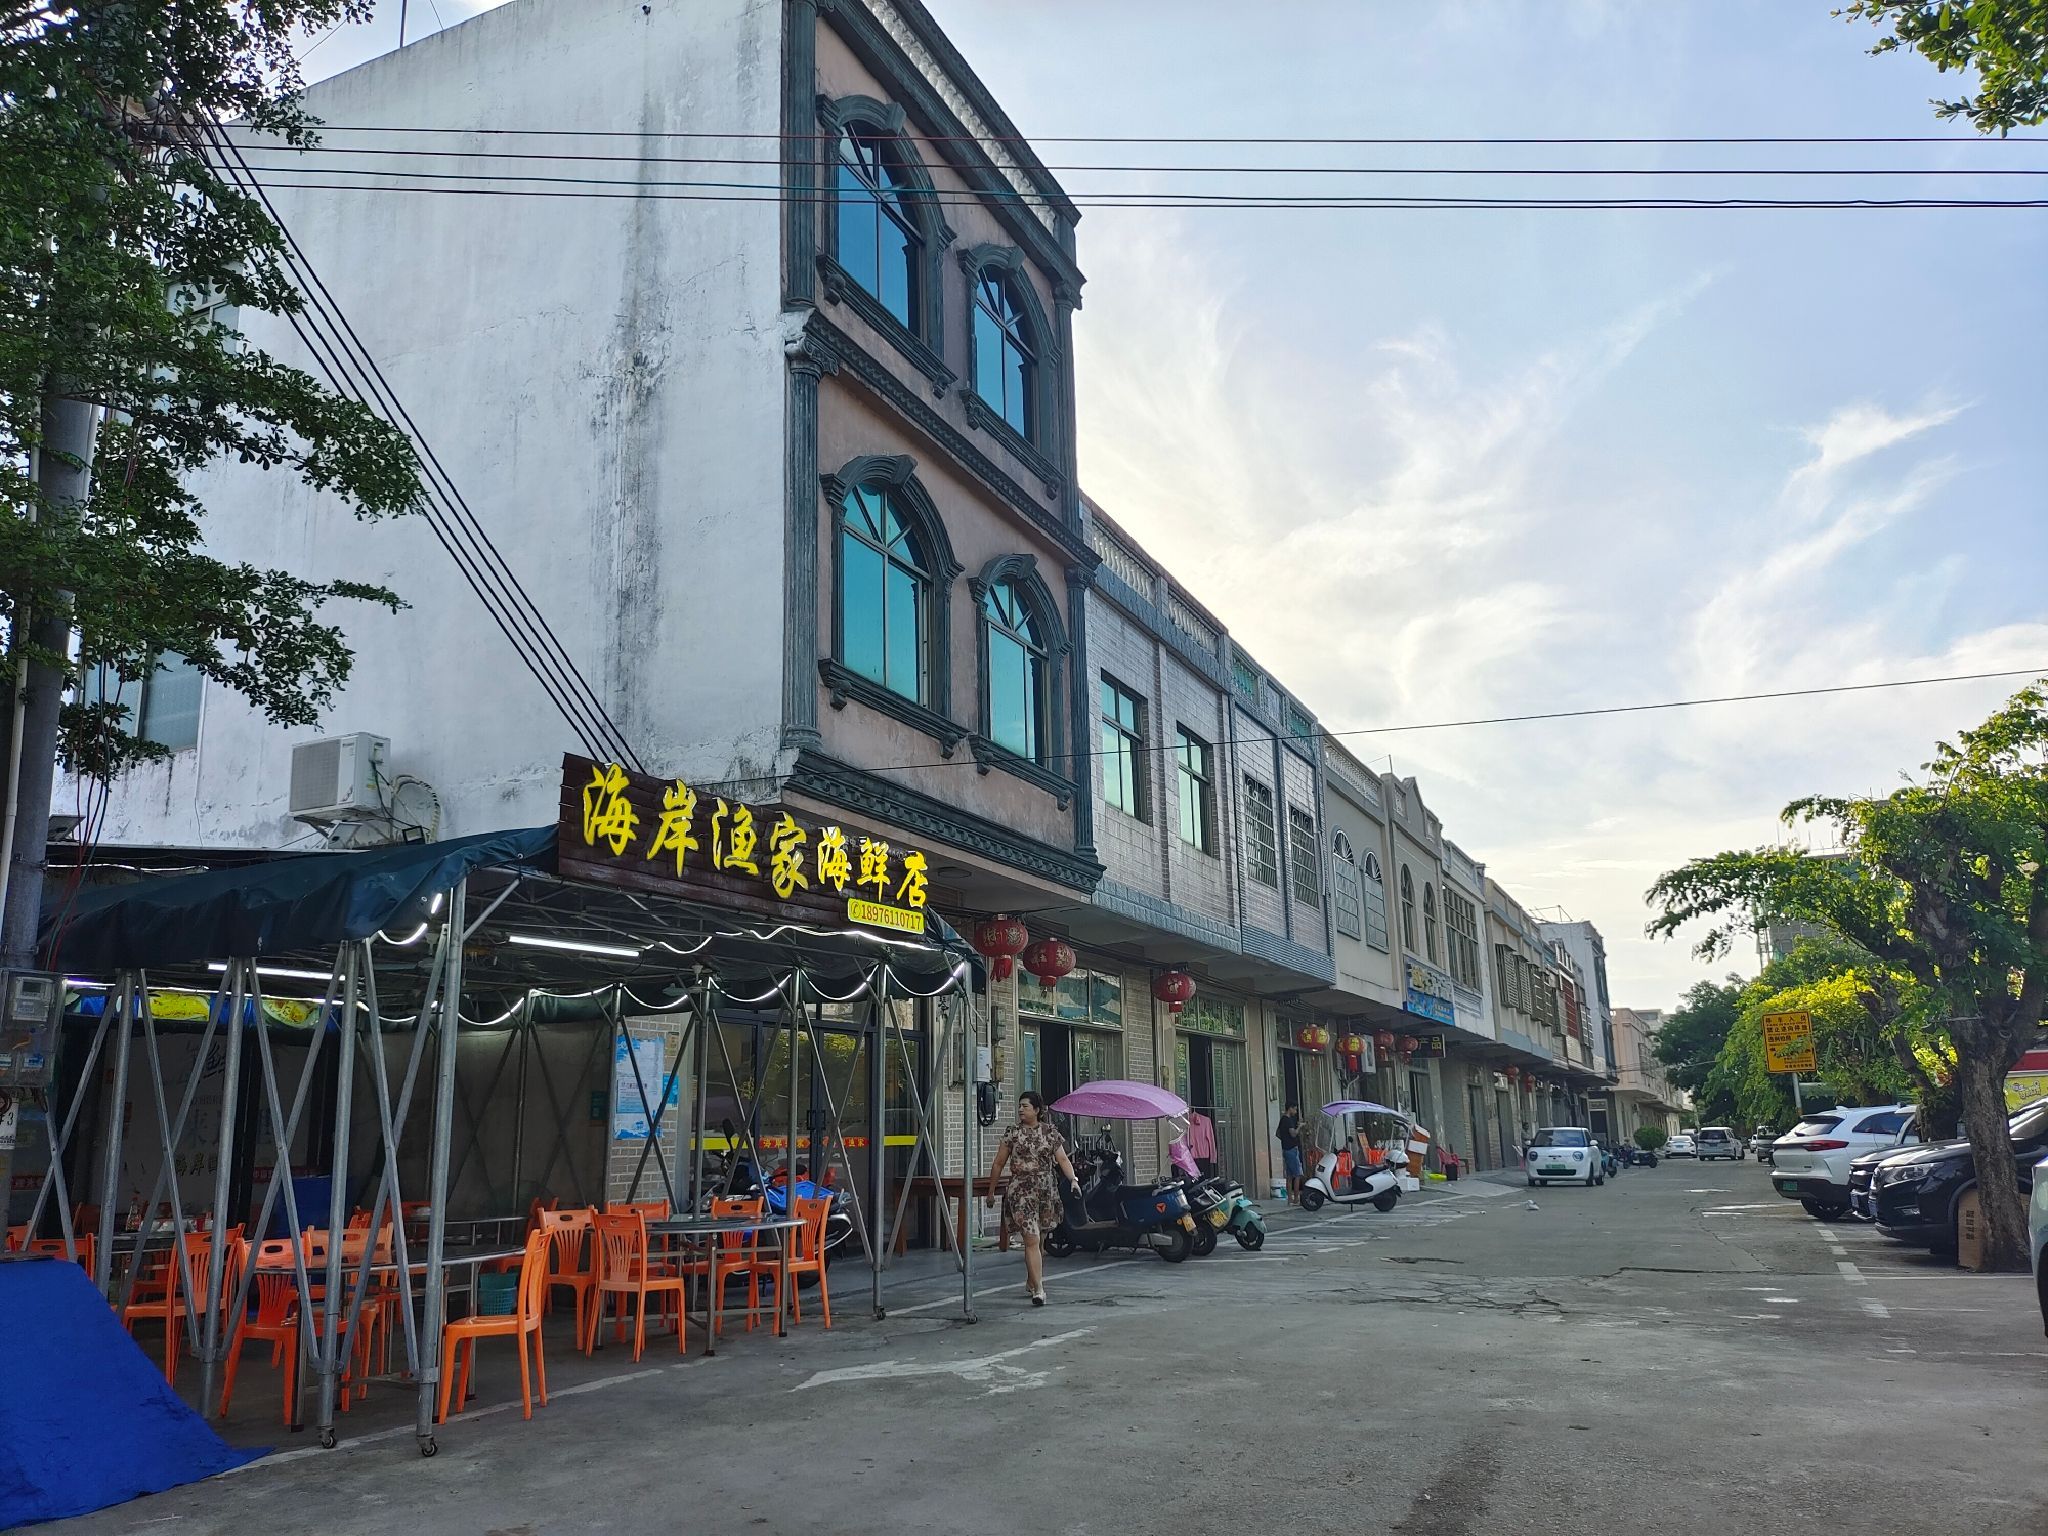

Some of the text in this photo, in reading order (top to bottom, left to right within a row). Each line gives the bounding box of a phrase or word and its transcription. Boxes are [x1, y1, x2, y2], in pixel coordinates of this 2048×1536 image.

[582, 762, 928, 908] 海岸渔家海鲜店
[861, 904, 921, 930] 18976110717
